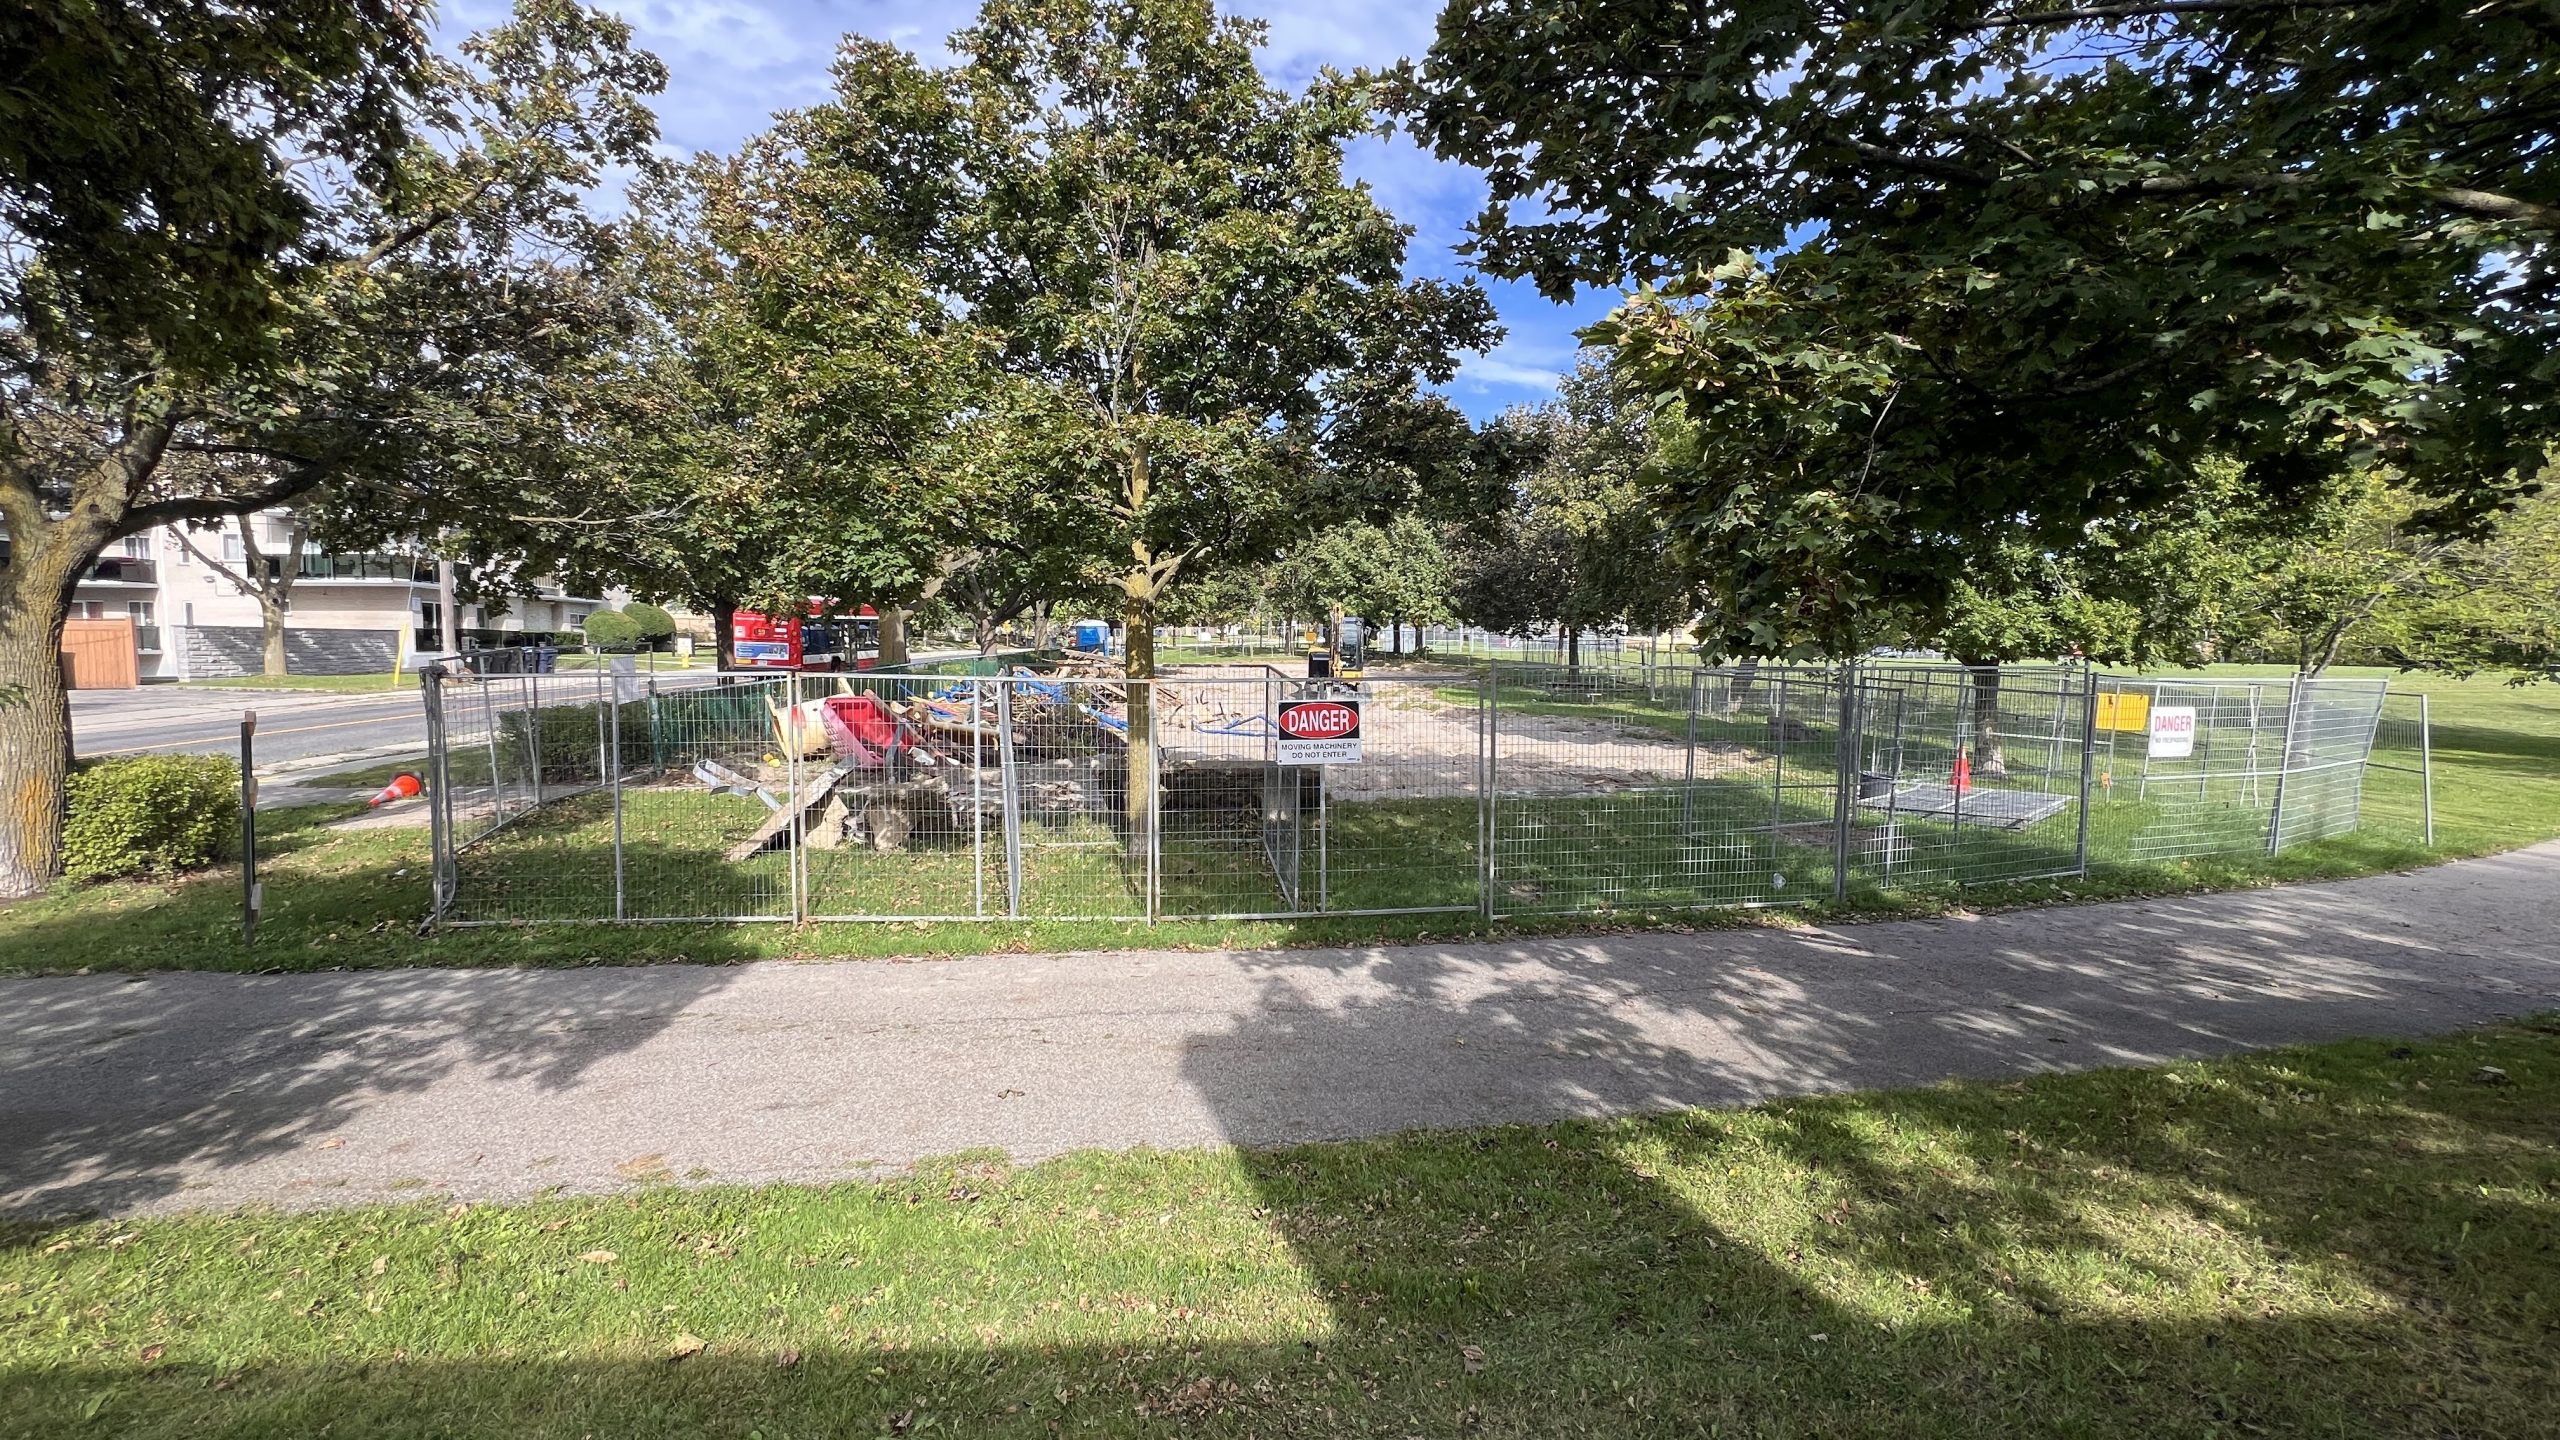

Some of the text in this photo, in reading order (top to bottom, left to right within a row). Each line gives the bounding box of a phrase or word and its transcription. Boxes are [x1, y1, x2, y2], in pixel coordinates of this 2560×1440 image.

[1288, 709, 1350, 732] DANGER
[2154, 715, 2192, 732] DANGER
[1281, 742, 1358, 751] MOVING MACHINERY
[1304, 751, 1321, 759] NOT
